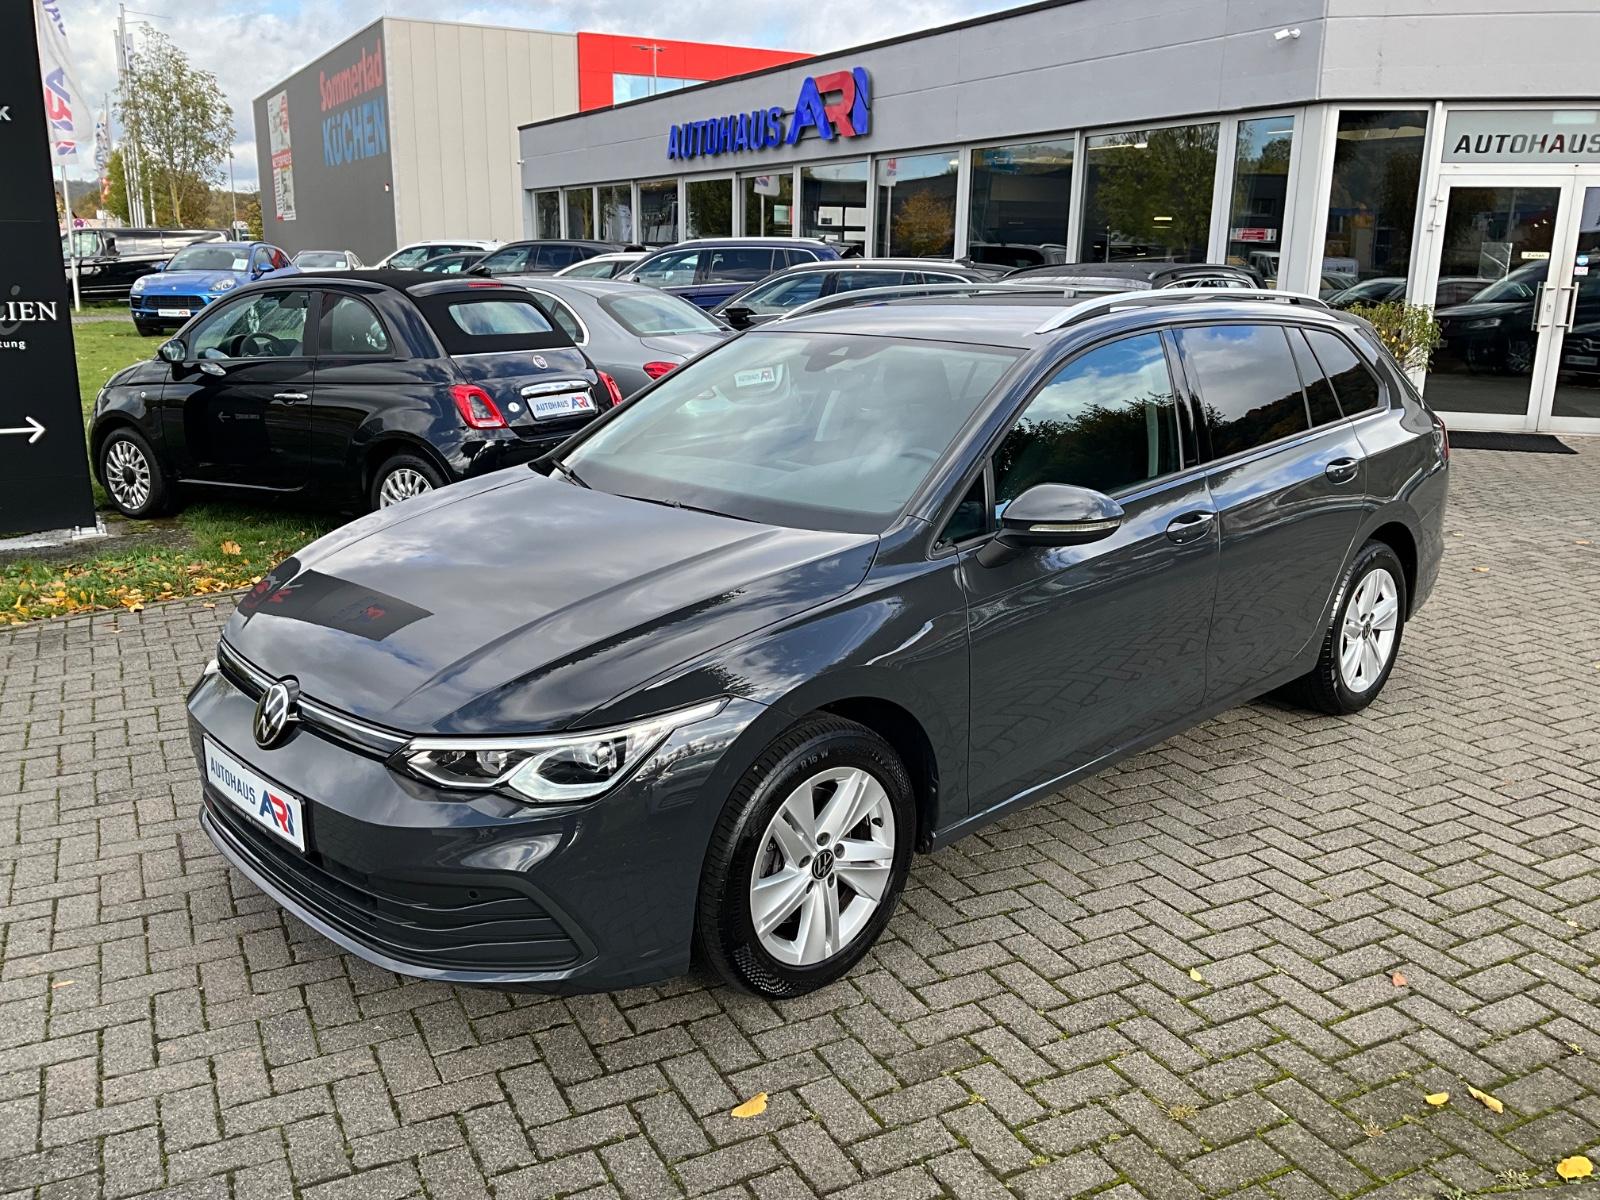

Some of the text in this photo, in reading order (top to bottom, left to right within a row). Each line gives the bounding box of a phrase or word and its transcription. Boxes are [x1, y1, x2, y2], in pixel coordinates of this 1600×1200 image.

[319, 38, 384, 112] Sommerlad
[667, 66, 872, 160] AUTOHAUS ARI
[1453, 133, 1600, 154] AUTOHAUS
[536, 395, 590, 411] AUTOHAUS ARI
[210, 757, 256, 805] AUTOHAUS
[259, 789, 295, 837] ARI
